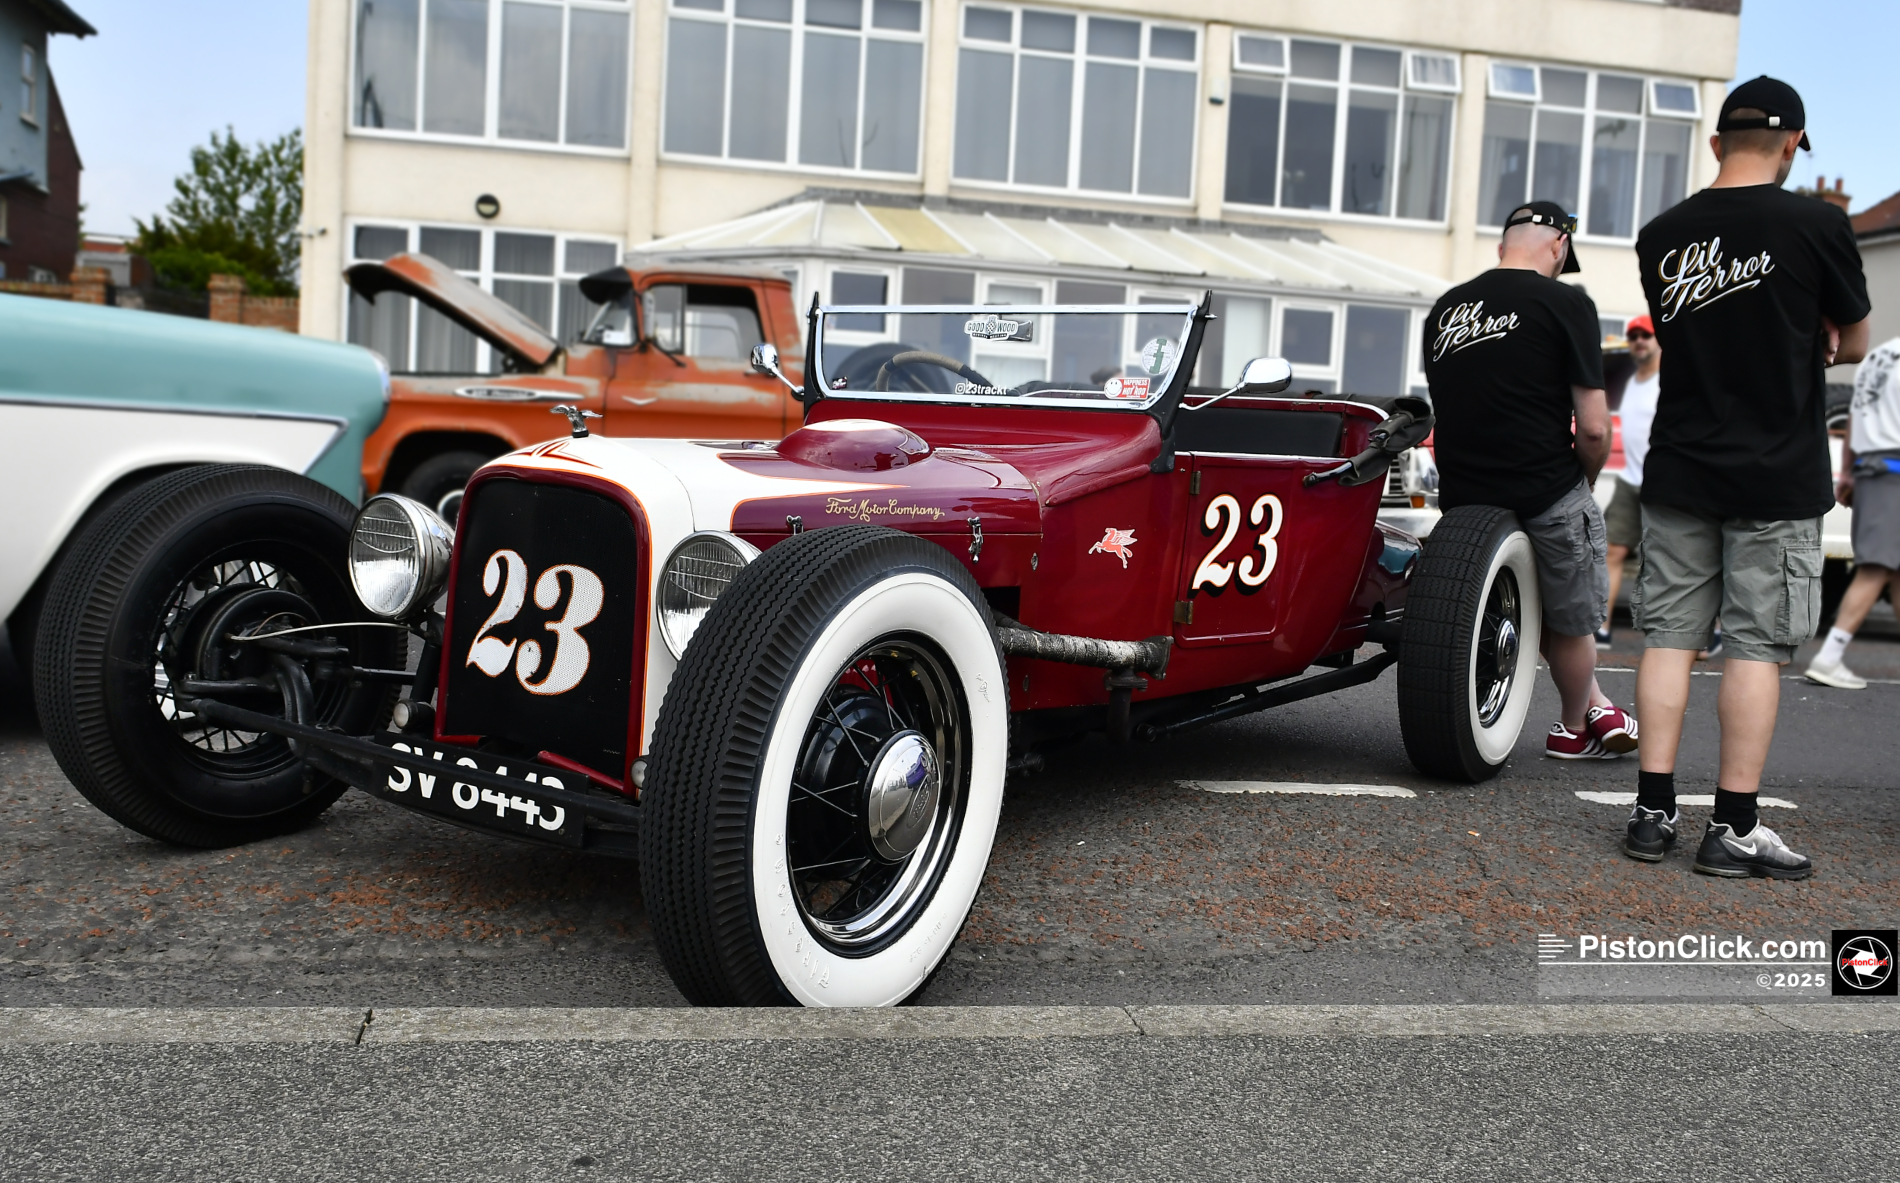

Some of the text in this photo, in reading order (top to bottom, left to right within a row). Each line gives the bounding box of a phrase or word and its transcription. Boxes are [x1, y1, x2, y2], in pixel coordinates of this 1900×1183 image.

[1660, 250, 1775, 323] Terror
[1432, 311, 1521, 362] Terror
[1122, 387, 1147, 396] HOT ROD
[825, 497, 945, 522] Ford Motor Company
[1192, 493, 1284, 590] 23
[465, 548, 605, 696] 23
